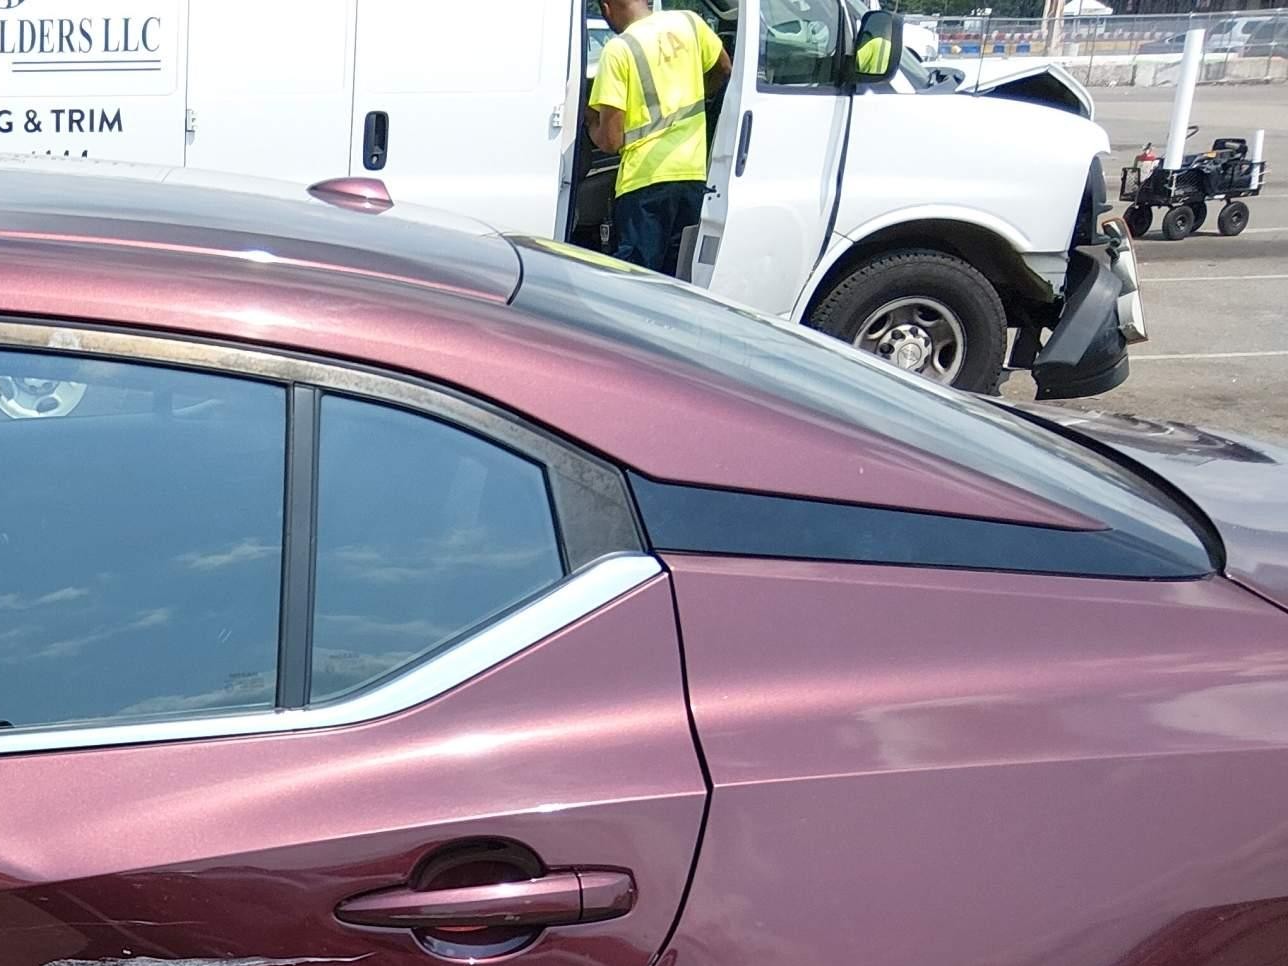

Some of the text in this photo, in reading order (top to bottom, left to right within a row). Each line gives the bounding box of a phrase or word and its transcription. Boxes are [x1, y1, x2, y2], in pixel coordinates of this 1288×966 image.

[102, 16, 161, 53] LLC
[23, 109, 43, 133] &
[50, 108, 124, 133] TRIM
